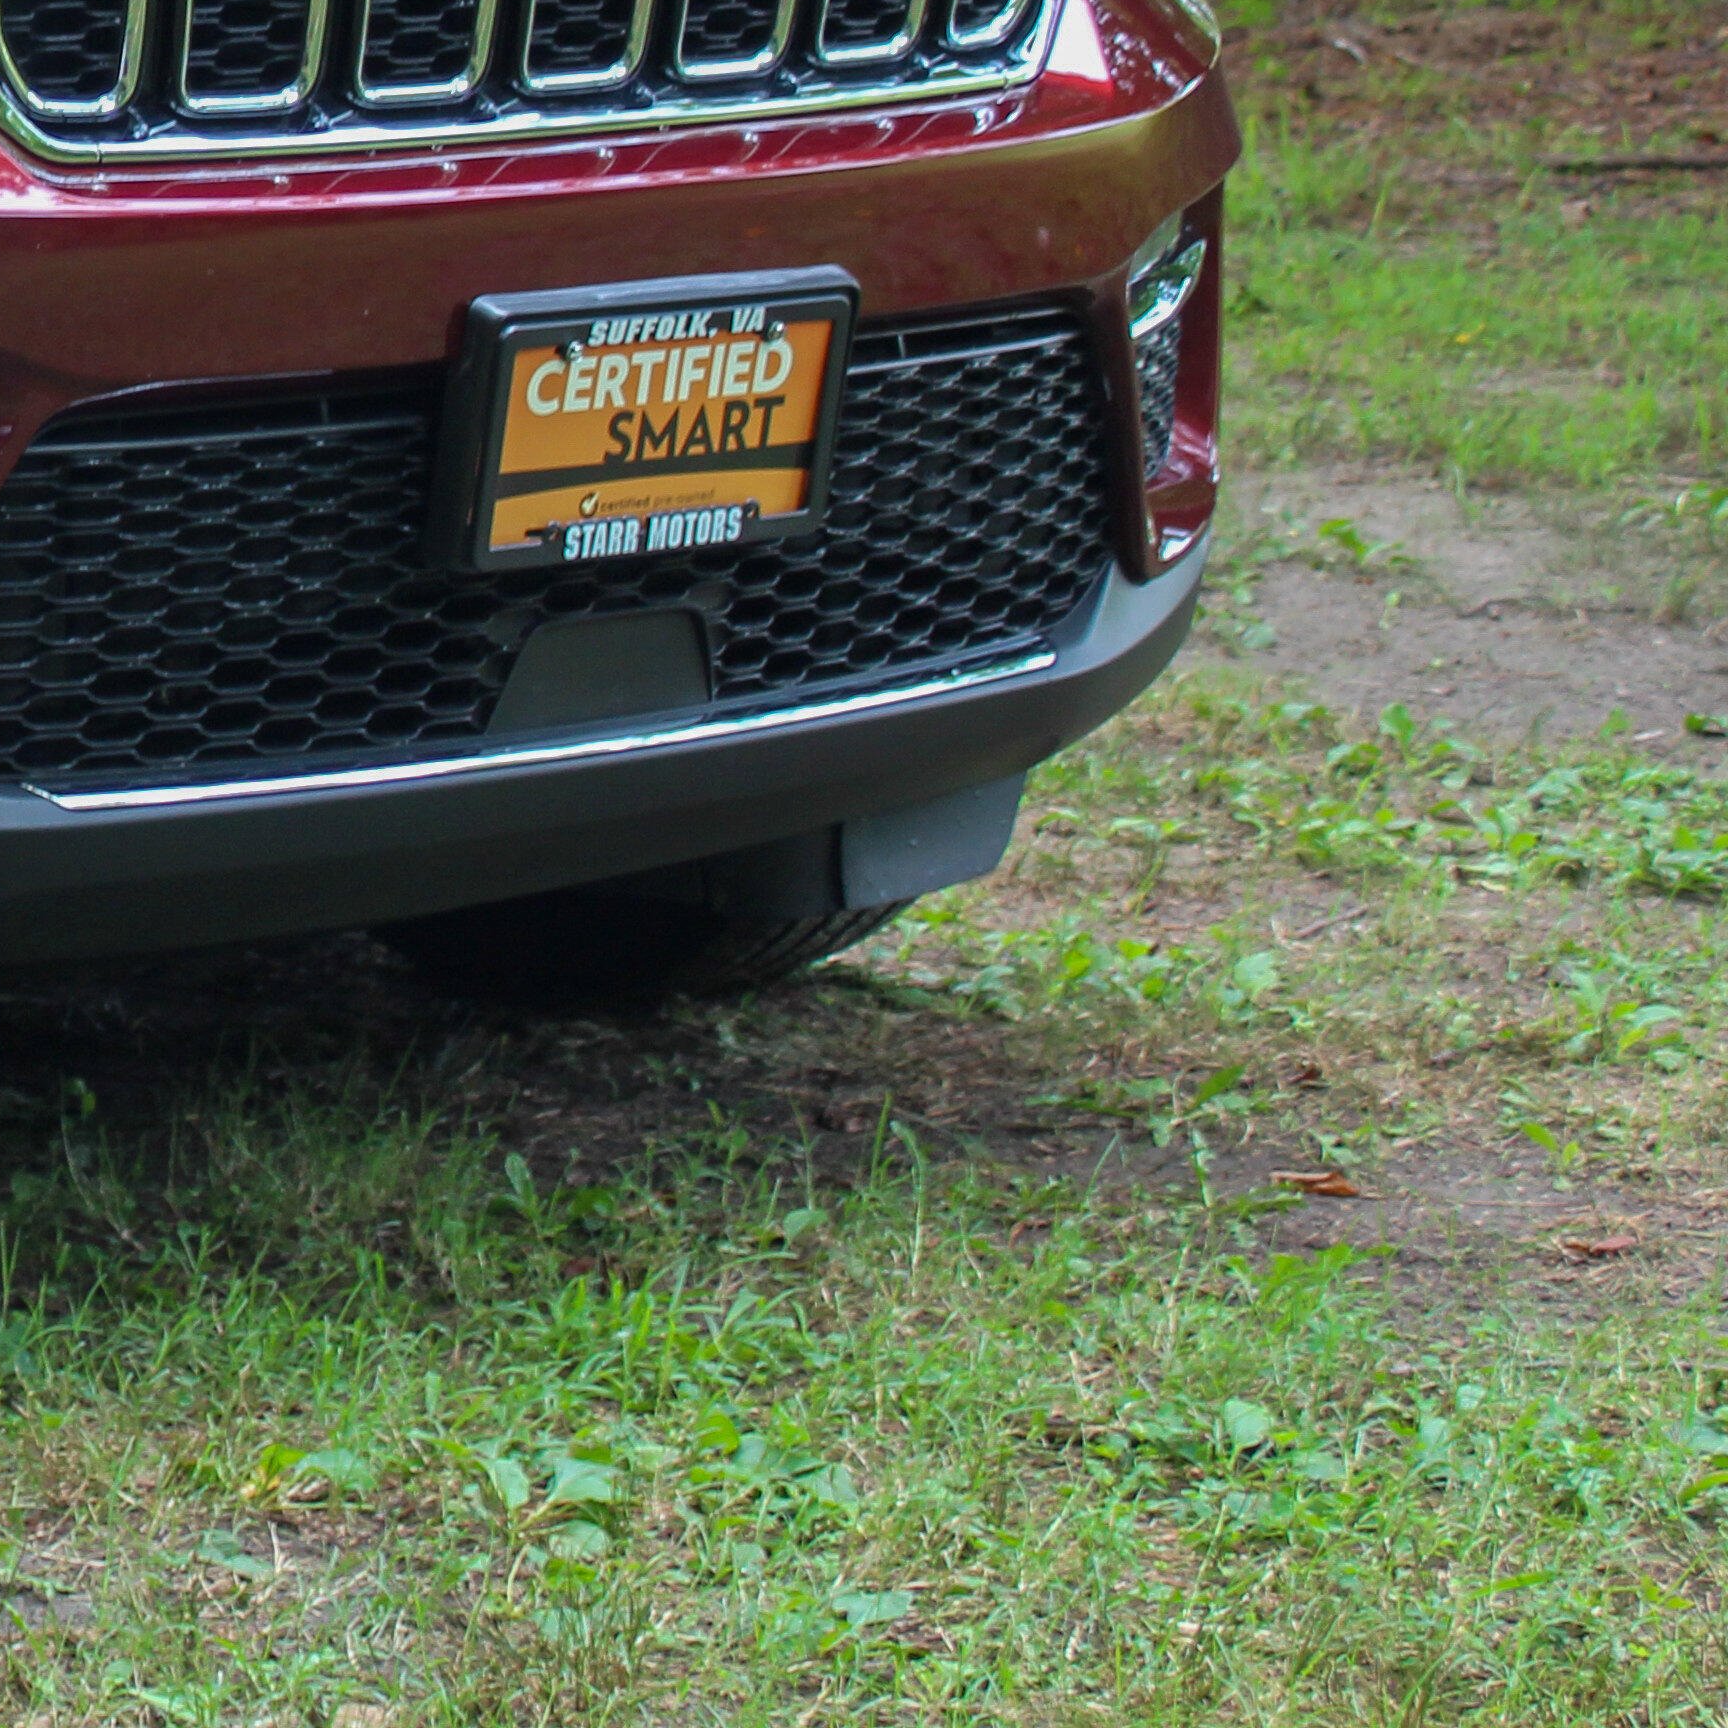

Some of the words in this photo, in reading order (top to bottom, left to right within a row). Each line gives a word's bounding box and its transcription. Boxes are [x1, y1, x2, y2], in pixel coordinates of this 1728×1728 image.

[587, 308, 718, 347] SUFFOLK,
[731, 305, 767, 333] VA
[526, 338, 794, 416] CERTIFIED
[602, 395, 787, 464] SMART
[563, 517, 640, 561] STARR
[645, 505, 744, 552] MOTORS
